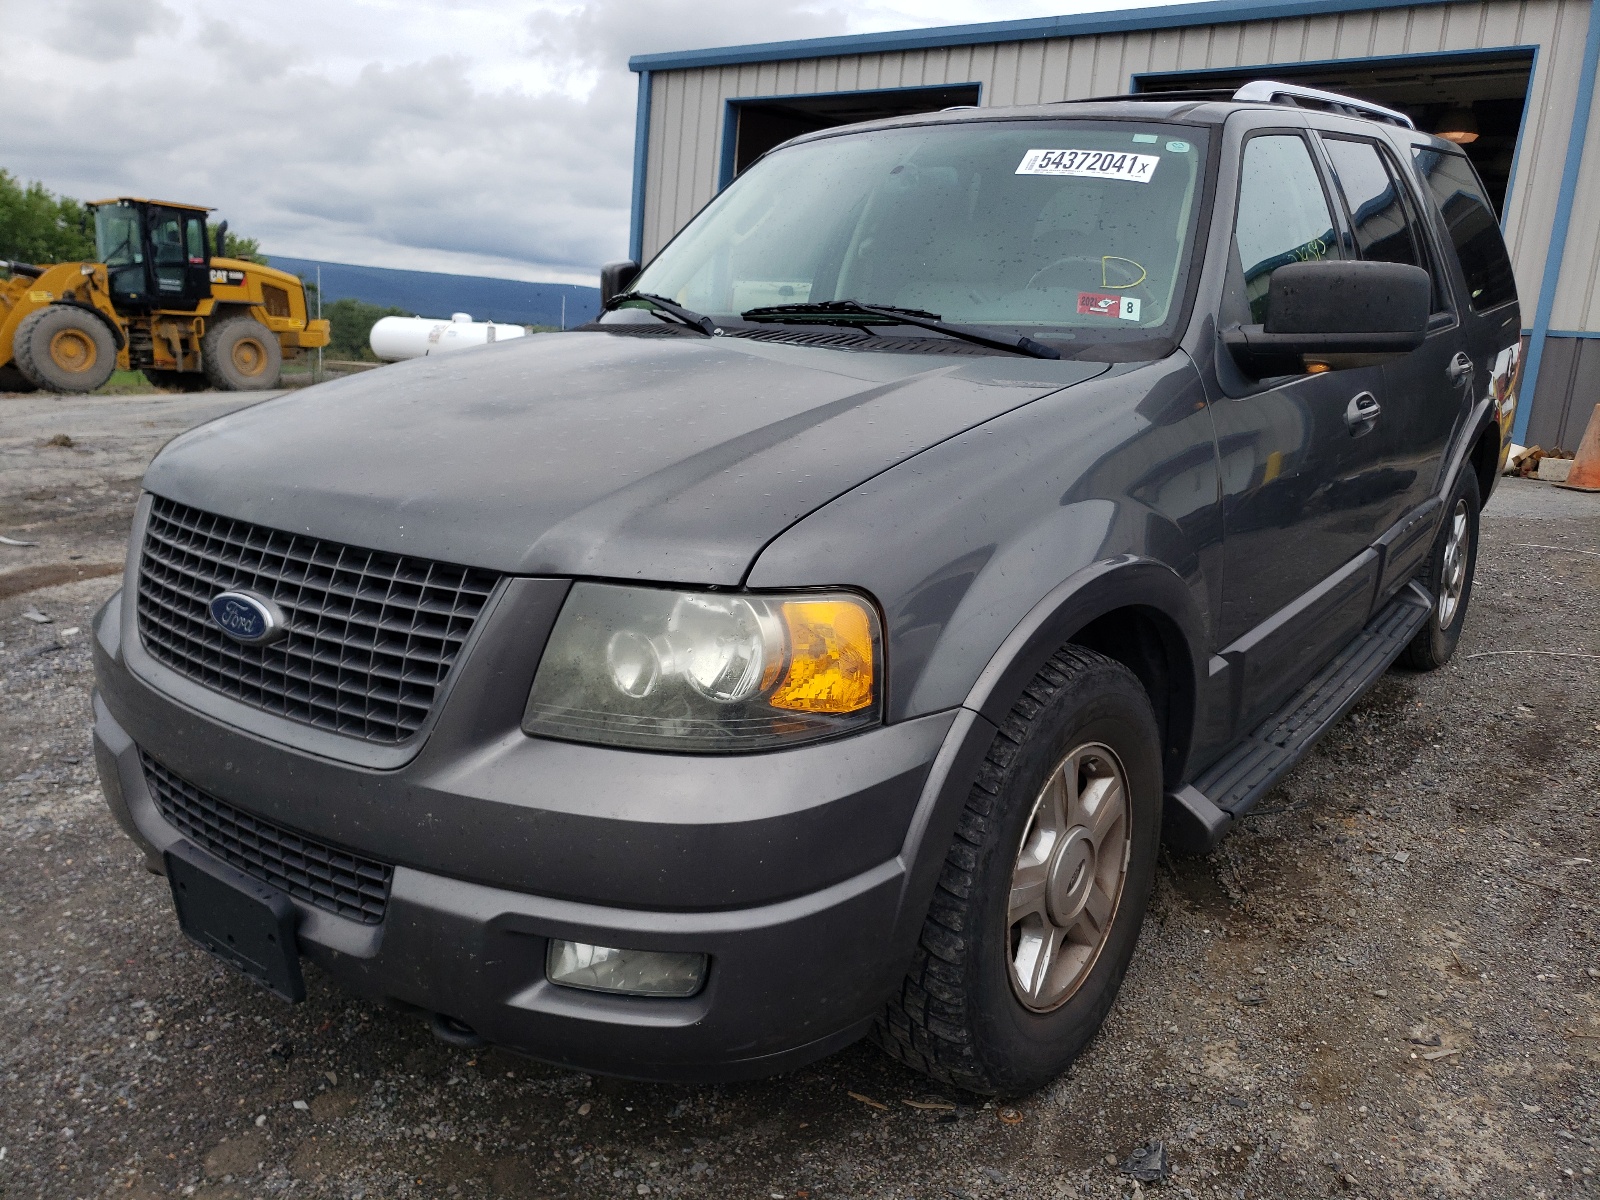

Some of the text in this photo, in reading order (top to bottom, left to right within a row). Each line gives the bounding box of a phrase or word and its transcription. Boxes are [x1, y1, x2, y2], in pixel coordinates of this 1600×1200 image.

[209, 269, 229, 283] CAT
[1126, 302, 1134, 314] 8
[221, 600, 257, 633] Ford
